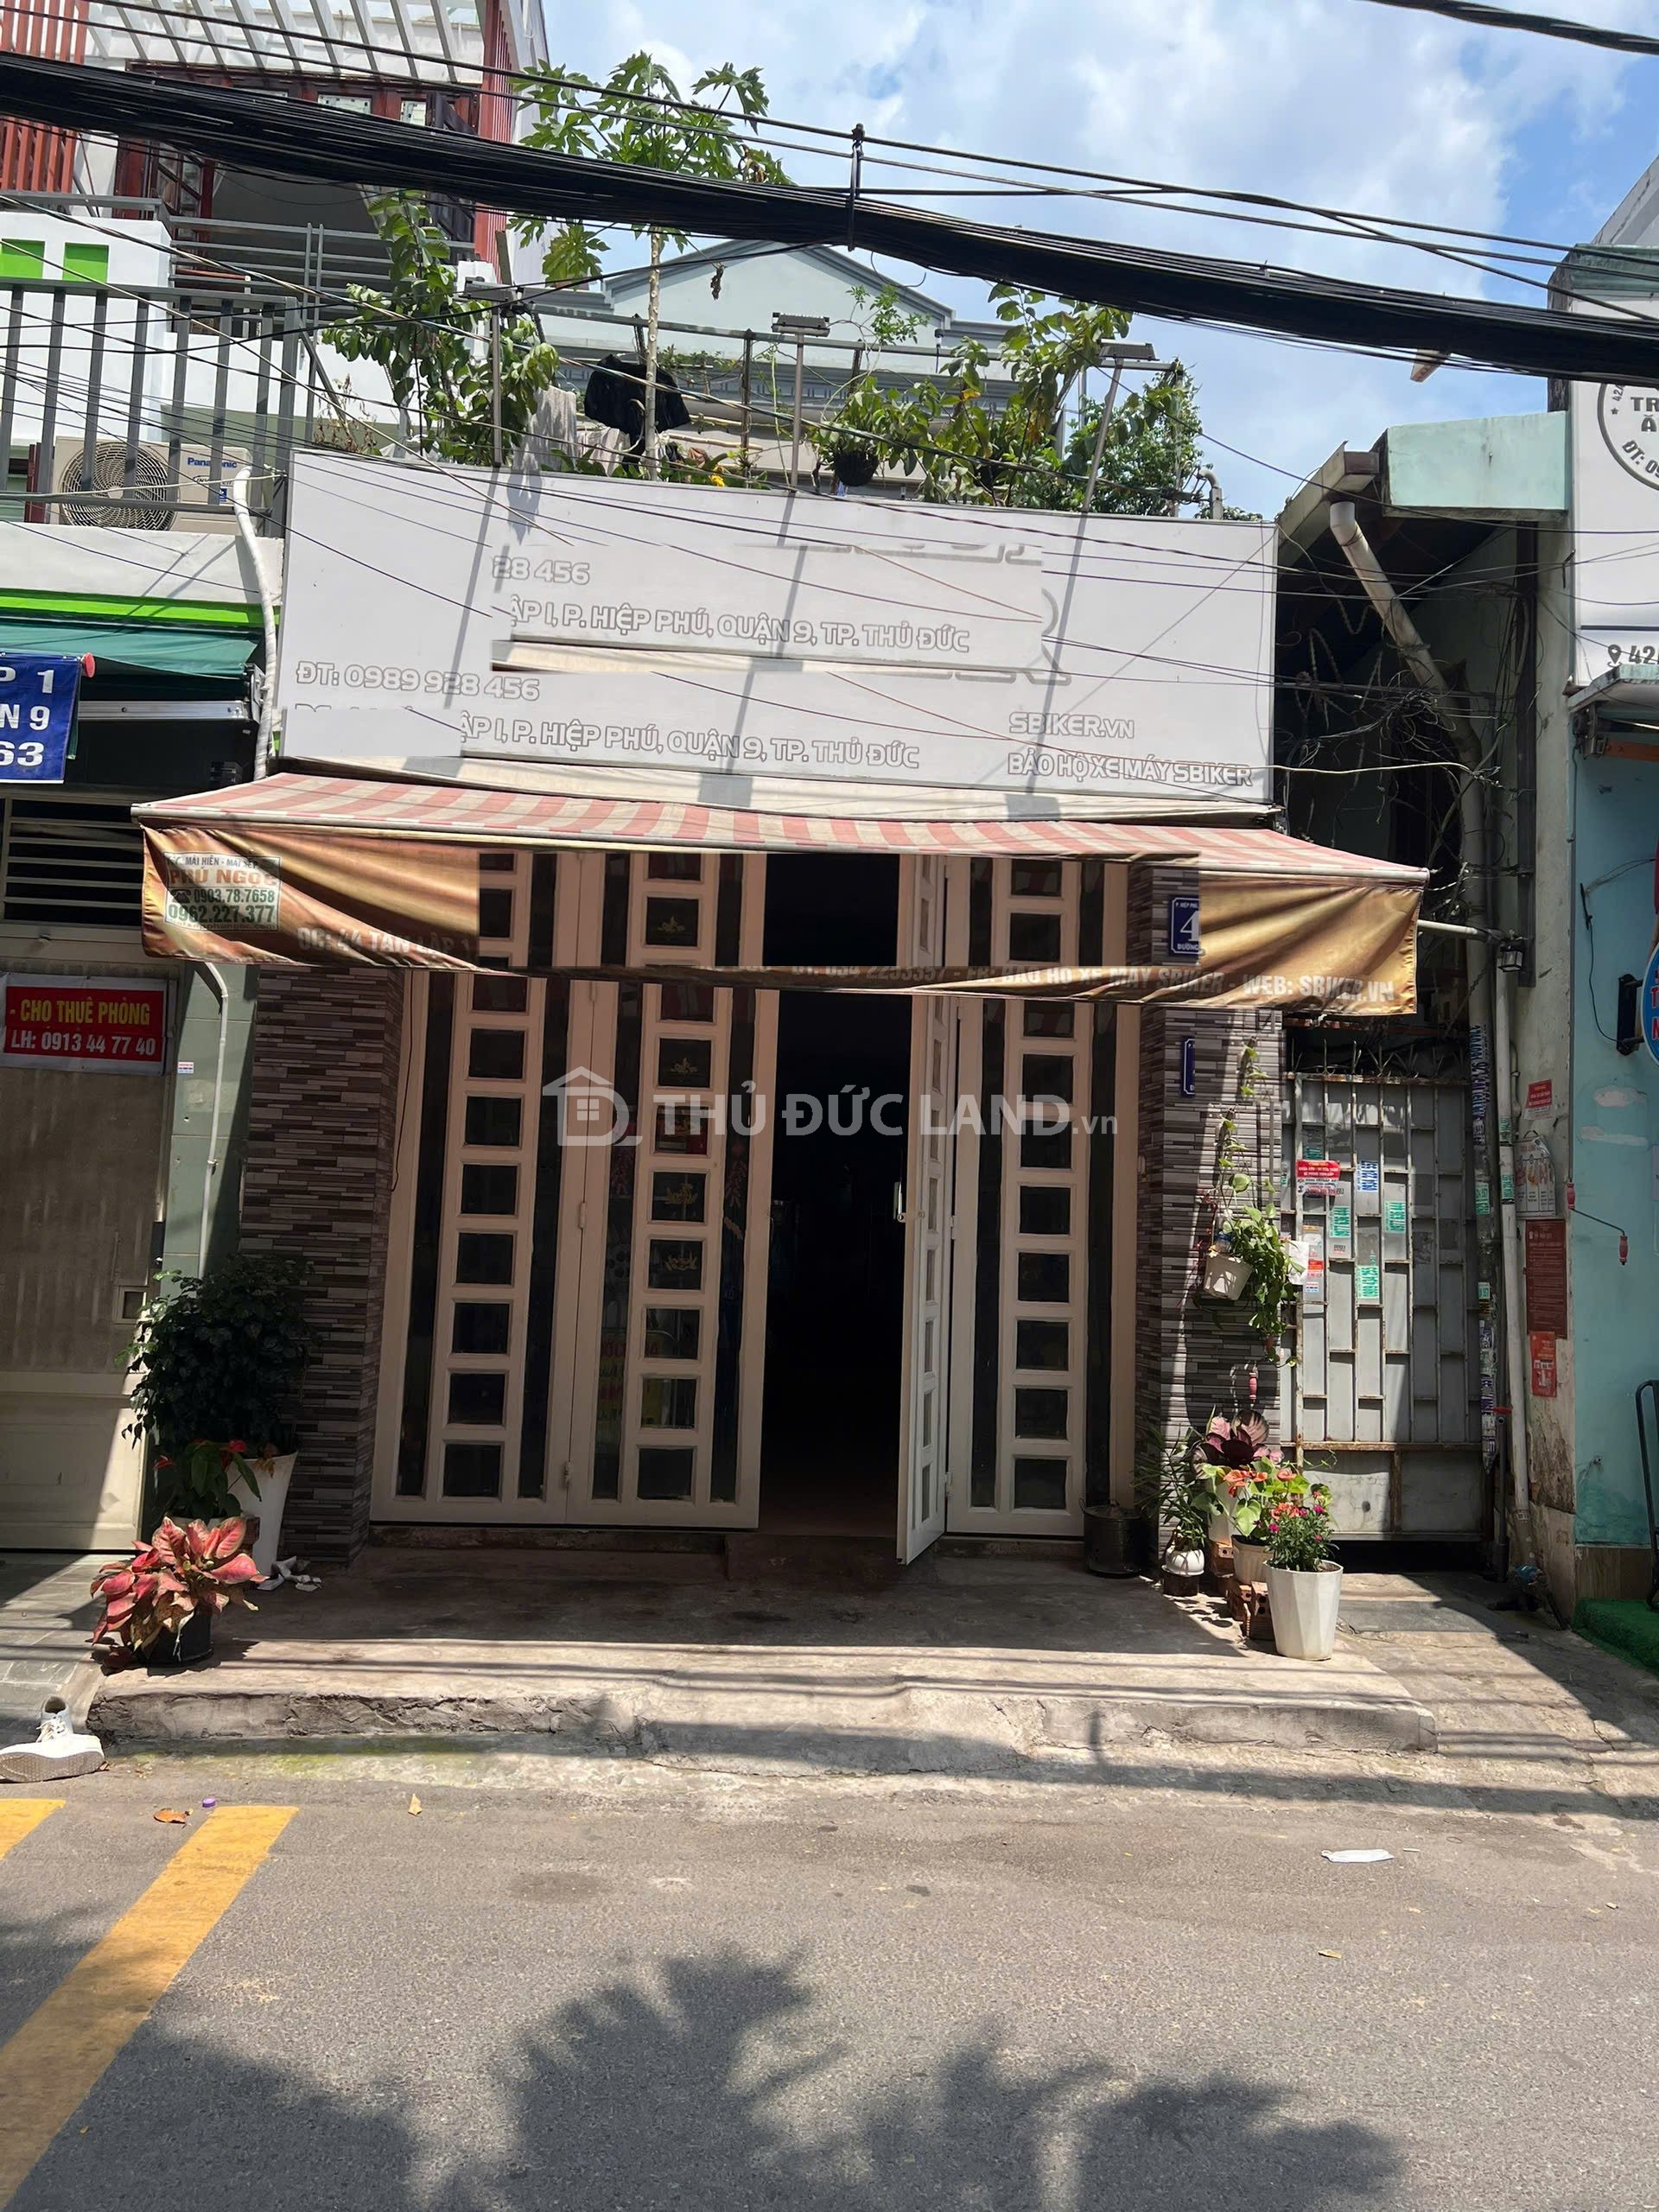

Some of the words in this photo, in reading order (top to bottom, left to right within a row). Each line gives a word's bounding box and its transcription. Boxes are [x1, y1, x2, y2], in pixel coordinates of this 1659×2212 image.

[187, 456, 238, 468] Pananic
[534, 559, 590, 585] 456
[563, 603, 587, 628] P.
[590, 603, 652, 636] HIỆP
[655, 607, 714, 639] PHÚ,
[717, 613, 790, 645] QUẬN
[793, 620, 818, 646] 9,
[821, 622, 860, 646] TP.
[863, 620, 914, 649] THỦ
[917, 623, 970, 652] ĐỨC
[1629, 645, 1659, 665] 42
[37, 669, 54, 694] 1
[296, 660, 340, 686] ĐT:
[344, 664, 420, 691] 0989
[424, 671, 480, 696] 928
[484, 675, 540, 701] 456
[29, 705, 50, 731] 9
[1009, 711, 1135, 739] SBIKER.VN
[512, 720, 537, 744] P.
[540, 718, 601, 752] HIỆP
[605, 723, 664, 753] PHÚ,
[667, 728, 741, 761] QUẬN
[743, 736, 767, 761] 9,
[771, 737, 809, 762] TP.
[812, 736, 863, 764] THỦ
[866, 739, 919, 768] ĐỨC
[1008, 747, 1054, 776] BẢO
[1058, 751, 1089, 782] HỘ
[1090, 754, 1123, 779] XE
[1123, 753, 1172, 781] MÁY
[1173, 761, 1253, 786] SBIKER
[169, 867, 208, 884] PHÚ
[168, 905, 275, 924] 0962.227.377
[1243, 974, 1294, 995] WEB:
[1299, 975, 1395, 1002] SBIKER.VN
[21, 999, 52, 1022] CHO
[56, 996, 95, 1024] THUÊ
[11, 1030, 36, 1049] LH:
[41, 1032, 82, 1052] 0913
[86, 1034, 106, 1054] 44
[111, 1036, 131, 1055] 77
[136, 1038, 156, 1056] 40
